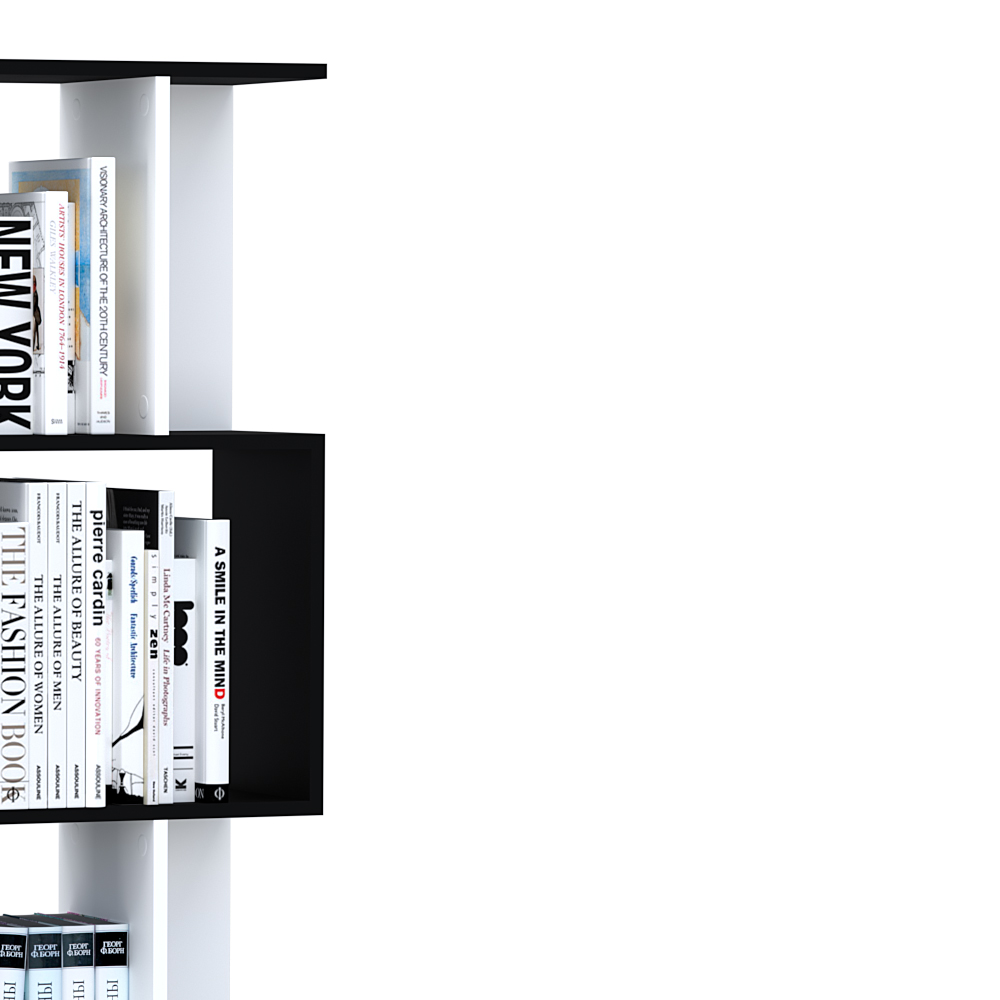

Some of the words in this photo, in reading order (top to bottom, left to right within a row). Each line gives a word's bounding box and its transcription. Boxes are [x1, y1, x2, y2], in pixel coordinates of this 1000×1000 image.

[99, 165, 108, 207] VISIONARY
[99, 207, 109, 271] ARCHITECTURE
[59, 277, 65, 287] IN
[99, 272, 109, 285] OF
[99, 286, 109, 304] THE
[99, 305, 109, 330] 20TH
[99, 331, 109, 377] CENTURY
[72, 500, 83, 533] THE
[90, 510, 105, 564] pierre
[214, 546, 226, 557] A
[1, 526, 26, 588] THE
[72, 536, 83, 595] ALLURE
[34, 574, 44, 603] THE
[53, 574, 62, 603] THE
[162, 568, 172, 593] Linda
[214, 562, 226, 605] SMILE
[72, 598, 83, 618] OF
[93, 569, 105, 626] cardin
[34, 605, 44, 658] ALLURE
[53, 605, 62, 658] ALLURE
[130, 613, 138, 640] Fantastic
[214, 611, 226, 625] IN
[1, 592, 26, 715] FASHION
[72, 621, 83, 682] BEAUTY
[149, 630, 158, 659] zen
[162, 649, 170, 664] Life
[214, 630, 226, 656] THE
[34, 660, 44, 679] OF
[53, 660, 62, 678] OF
[130, 642, 138, 679] Architecture
[162, 665, 170, 675] in
[95, 676, 102, 686] OF
[214, 660, 226, 700] MIND
[34, 681, 44, 734] WOMEN
[53, 681, 62, 711] MEN
[161, 677, 171, 727] Photographs
[1, 722, 26, 804] BOOK
[1, 943, 23, 952] ГЕОРГ
[34, 943, 58, 951] ГЕОРГ
[68, 942, 89, 950] ГЕОРГ
[103, 940, 123, 948] ГЕОРГ
